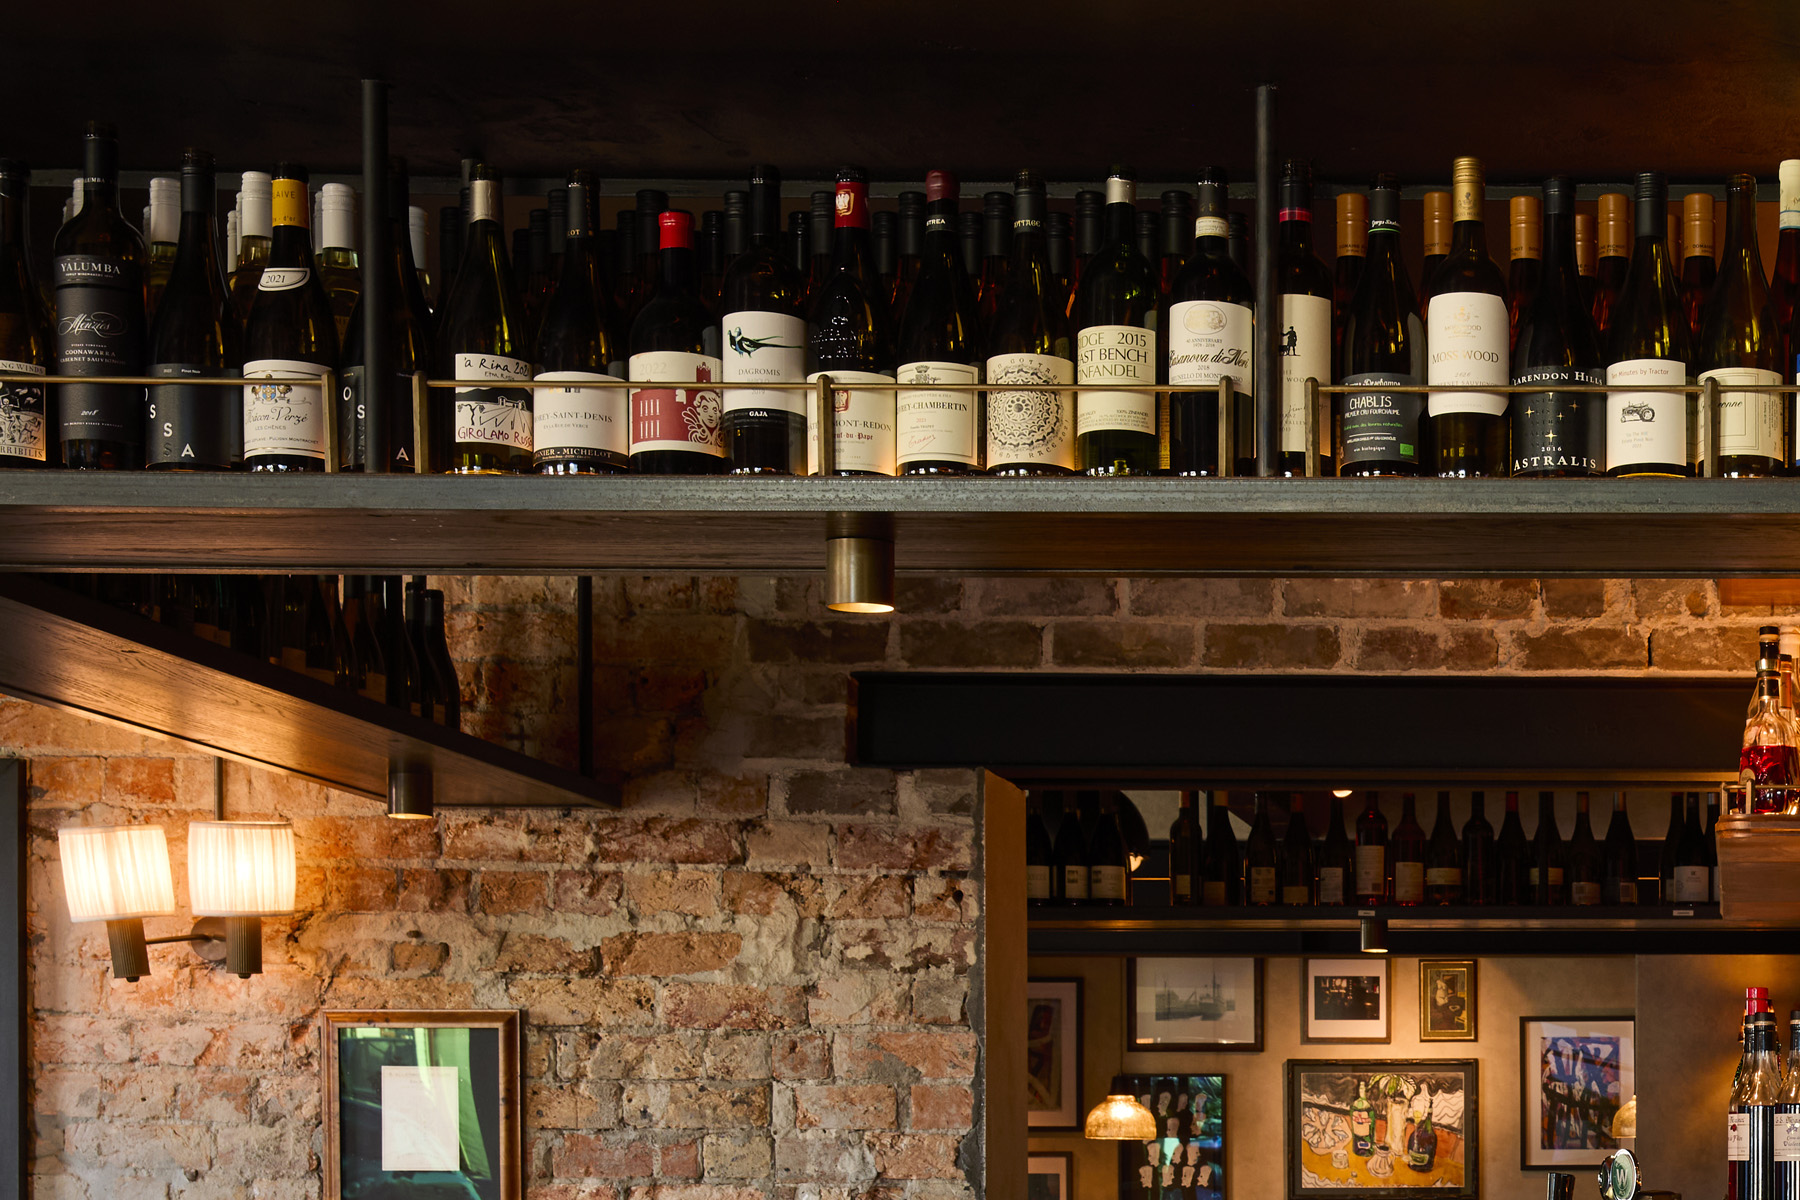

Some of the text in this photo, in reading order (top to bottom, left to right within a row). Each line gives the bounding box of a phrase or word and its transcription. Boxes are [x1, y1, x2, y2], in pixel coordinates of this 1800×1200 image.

[60, 262, 121, 275] YALUMBA
[266, 275, 286, 284] 2021
[1117, 332, 1147, 346] 2015
[65, 349, 116, 357] COONAWARRA
[1099, 348, 1147, 364] BENCH
[1223, 349, 1249, 368] Neri
[1432, 350, 1499, 364] MOSS WOOD
[479, 358, 511, 373] Rina
[738, 368, 780, 376] DAGROMIS
[1618, 368, 1669, 378] Minutes by Tractor
[1350, 396, 1392, 410] CHABLIS
[749, 410, 768, 418] GAJA
[458, 426, 510, 442] GIROLAMO
[563, 448, 612, 458] MICHELOT
[1514, 455, 1597, 472] ASTRALIS
